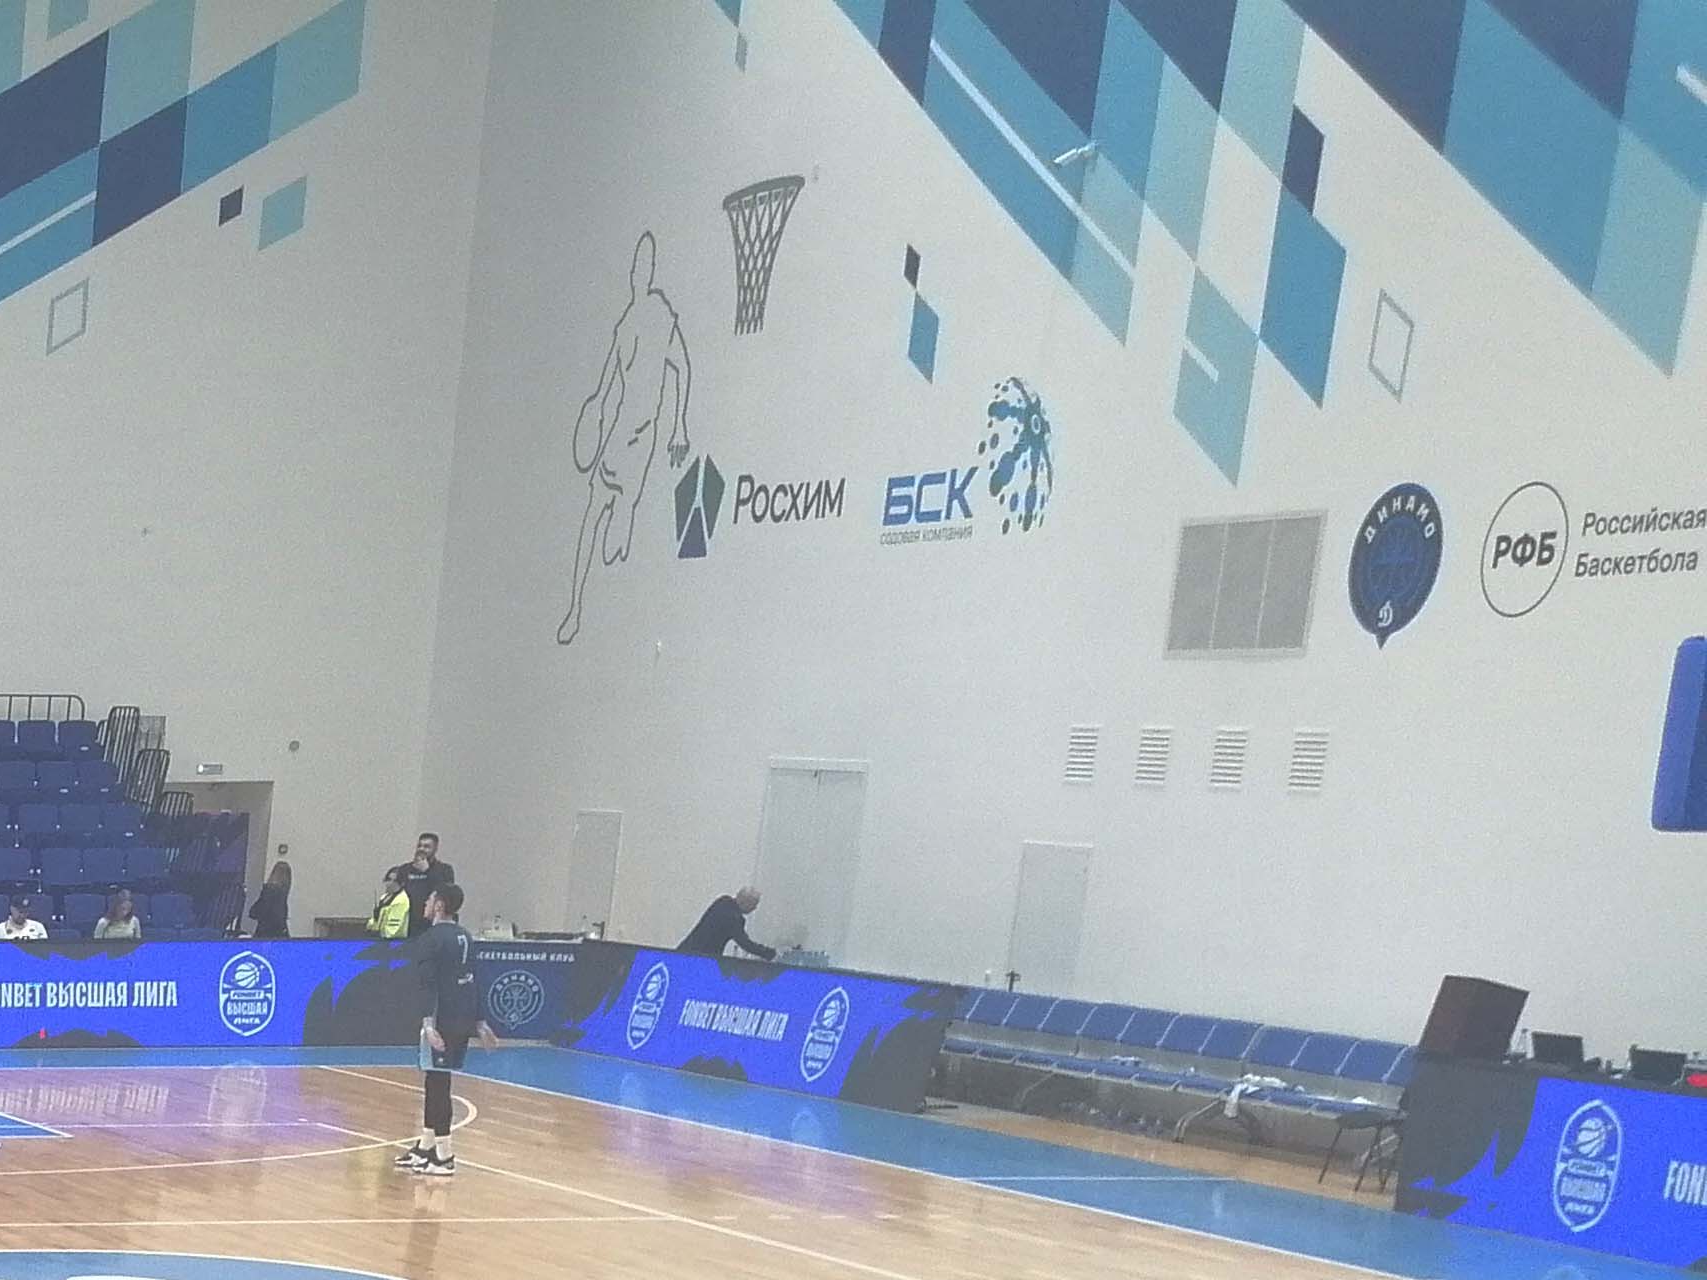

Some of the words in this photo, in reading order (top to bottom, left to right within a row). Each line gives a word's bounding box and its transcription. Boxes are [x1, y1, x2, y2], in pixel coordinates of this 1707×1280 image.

[882, 466, 979, 527] БСК
[1365, 495, 1436, 544] ДИНАМО
[1582, 507, 1707, 537] Российская
[1491, 531, 1558, 569] РФБ
[1574, 548, 1699, 578] Баскетбола
[46, 982, 128, 1009] ВЫСШАЯ
[132, 981, 178, 1008] ЛИГА
